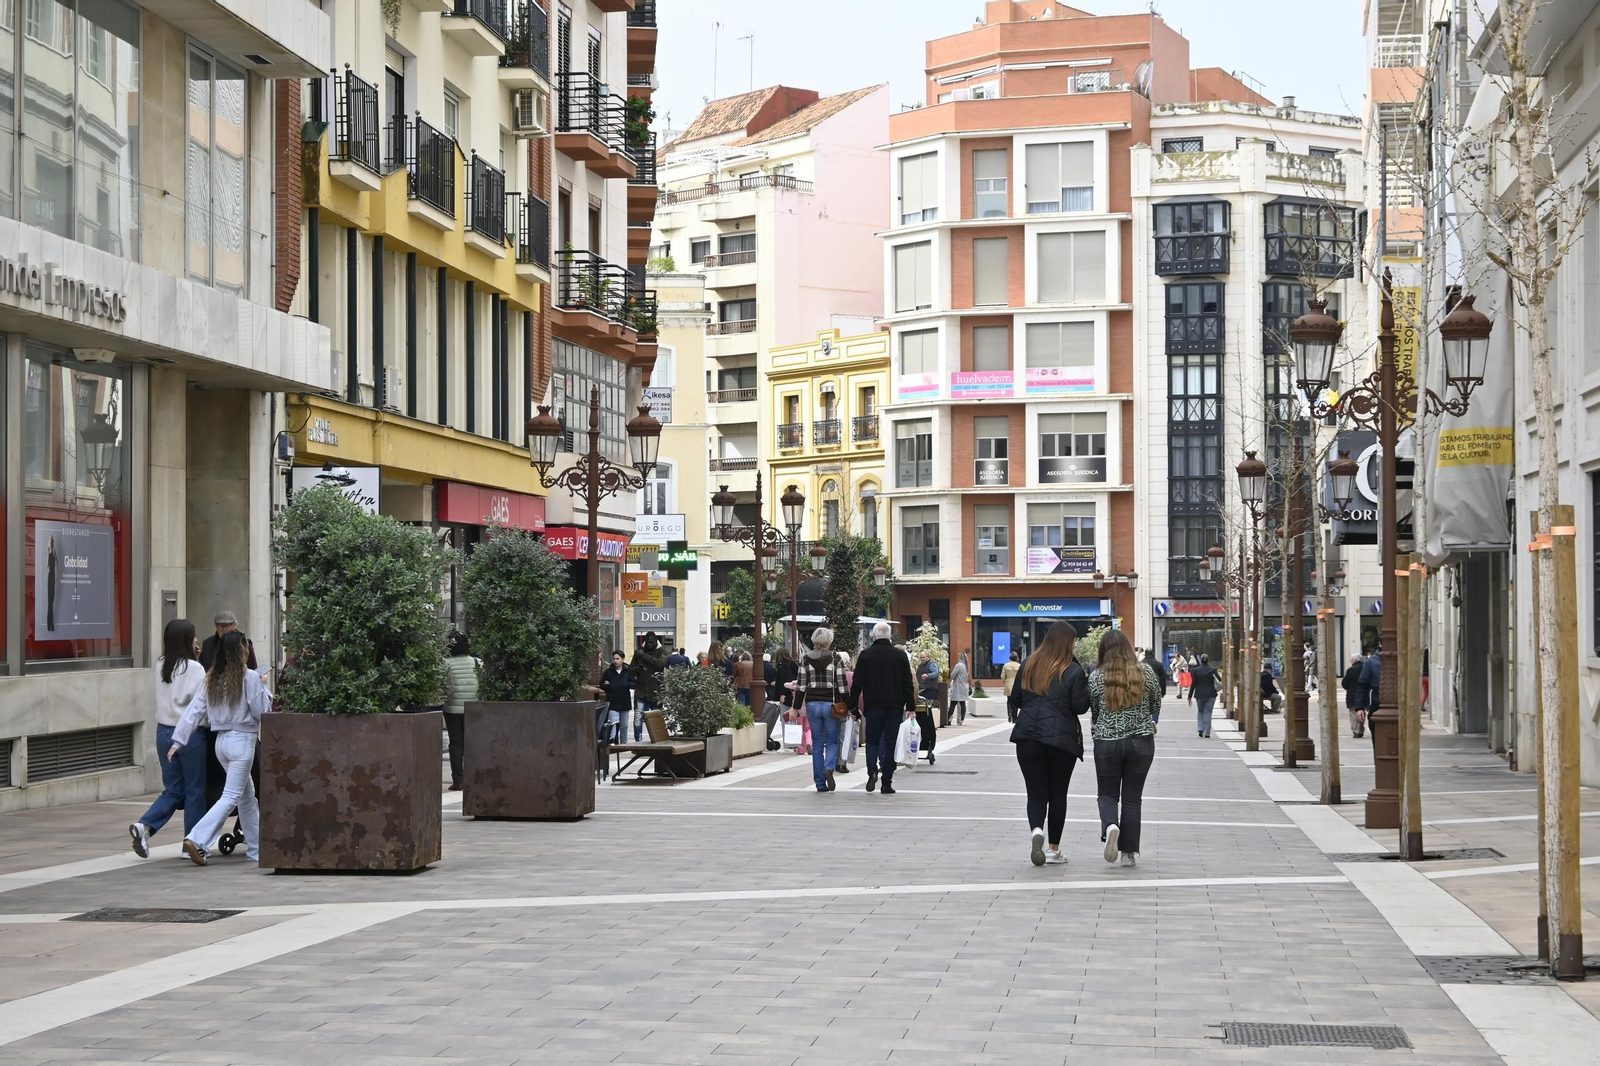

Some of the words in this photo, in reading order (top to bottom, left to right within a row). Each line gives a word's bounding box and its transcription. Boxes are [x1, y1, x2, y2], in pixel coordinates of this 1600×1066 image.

[45, 262, 127, 322] Empresas
[1404, 291, 1416, 345] ESTAOS
[957, 374, 1011, 384] huelvaderm
[315, 417, 330, 432] CALLE
[308, 428, 322, 442] PLUS
[323, 431, 339, 447] ULTRA
[1440, 434, 1471, 443] ESTAMOS
[1472, 433, 1514, 441] TRABAJAND
[1457, 443, 1466, 451] EL
[491, 495, 509, 523] GAES
[1341, 509, 1378, 521] CORT
[62, 528, 90, 537] BIENESTANDO
[547, 537, 574, 546] GAES
[64, 555, 88, 568] Globalidad
[1173, 602, 1238, 615] Solopticl
